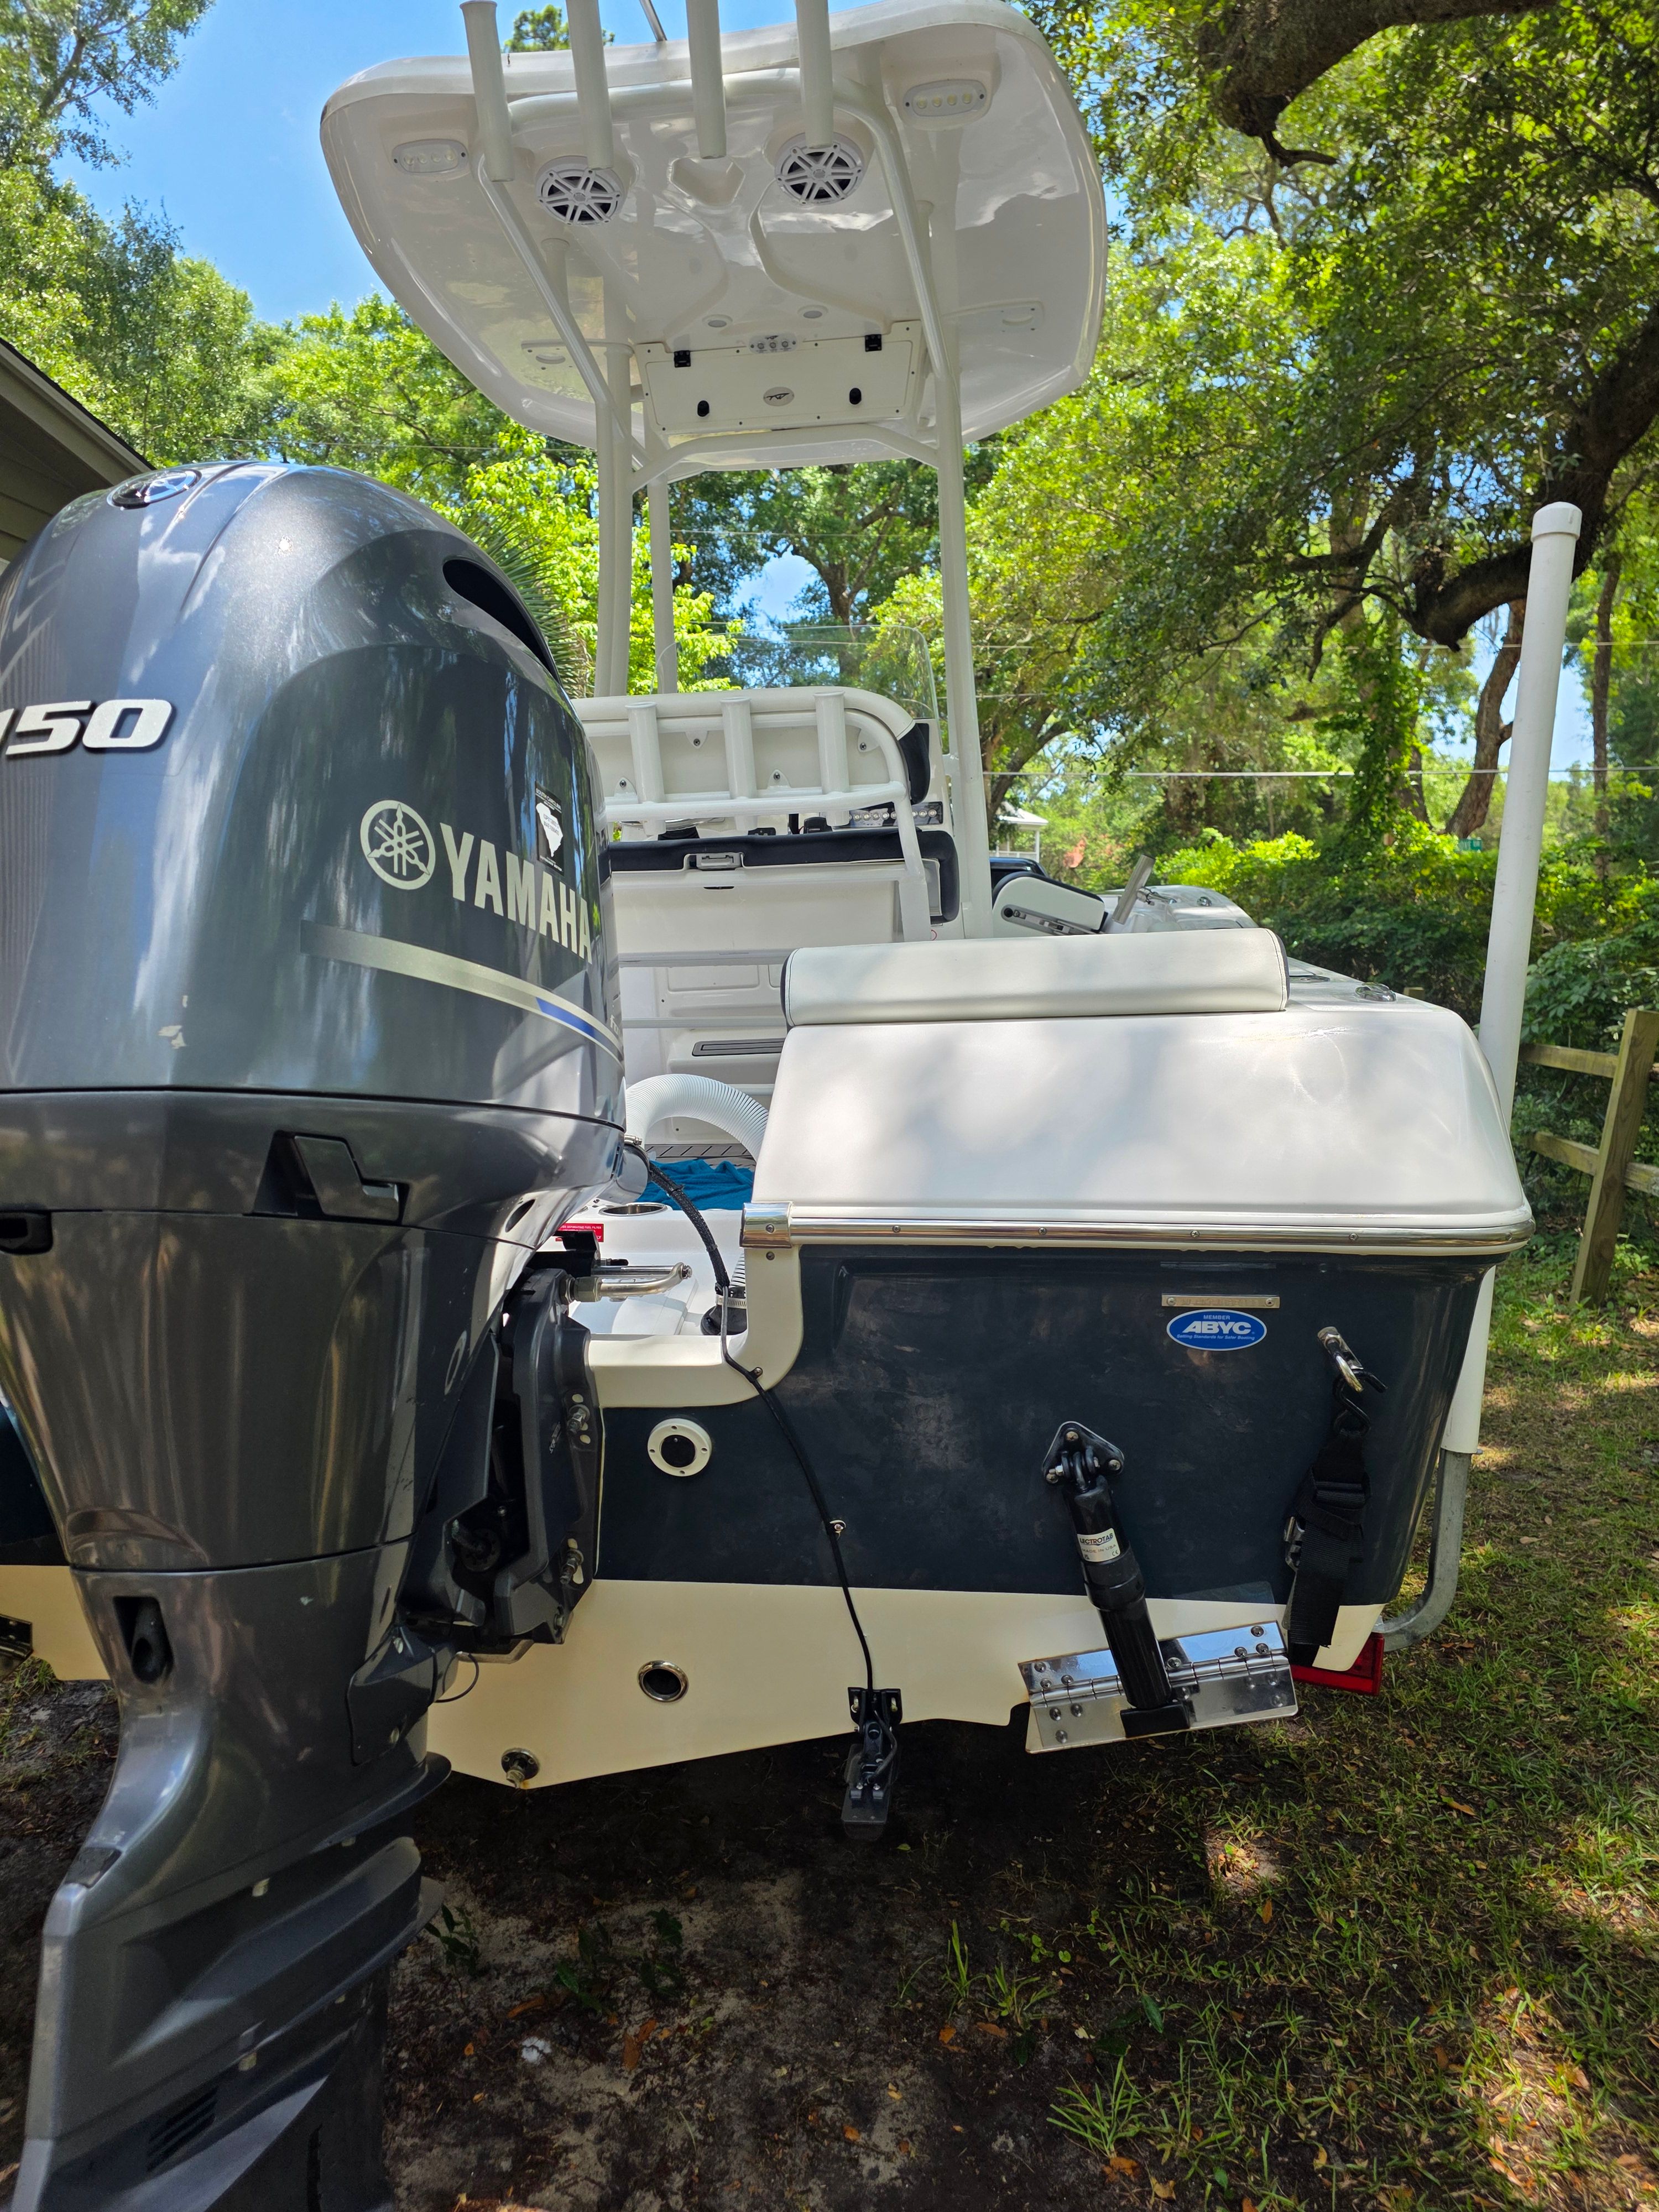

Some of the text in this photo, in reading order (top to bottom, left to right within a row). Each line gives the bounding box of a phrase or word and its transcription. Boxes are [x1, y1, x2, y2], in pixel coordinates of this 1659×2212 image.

[440, 822, 592, 964] YAMAHA
[1182, 1321, 1251, 1335] ABYC
[1079, 1533, 1113, 1545] LECTROTAB
